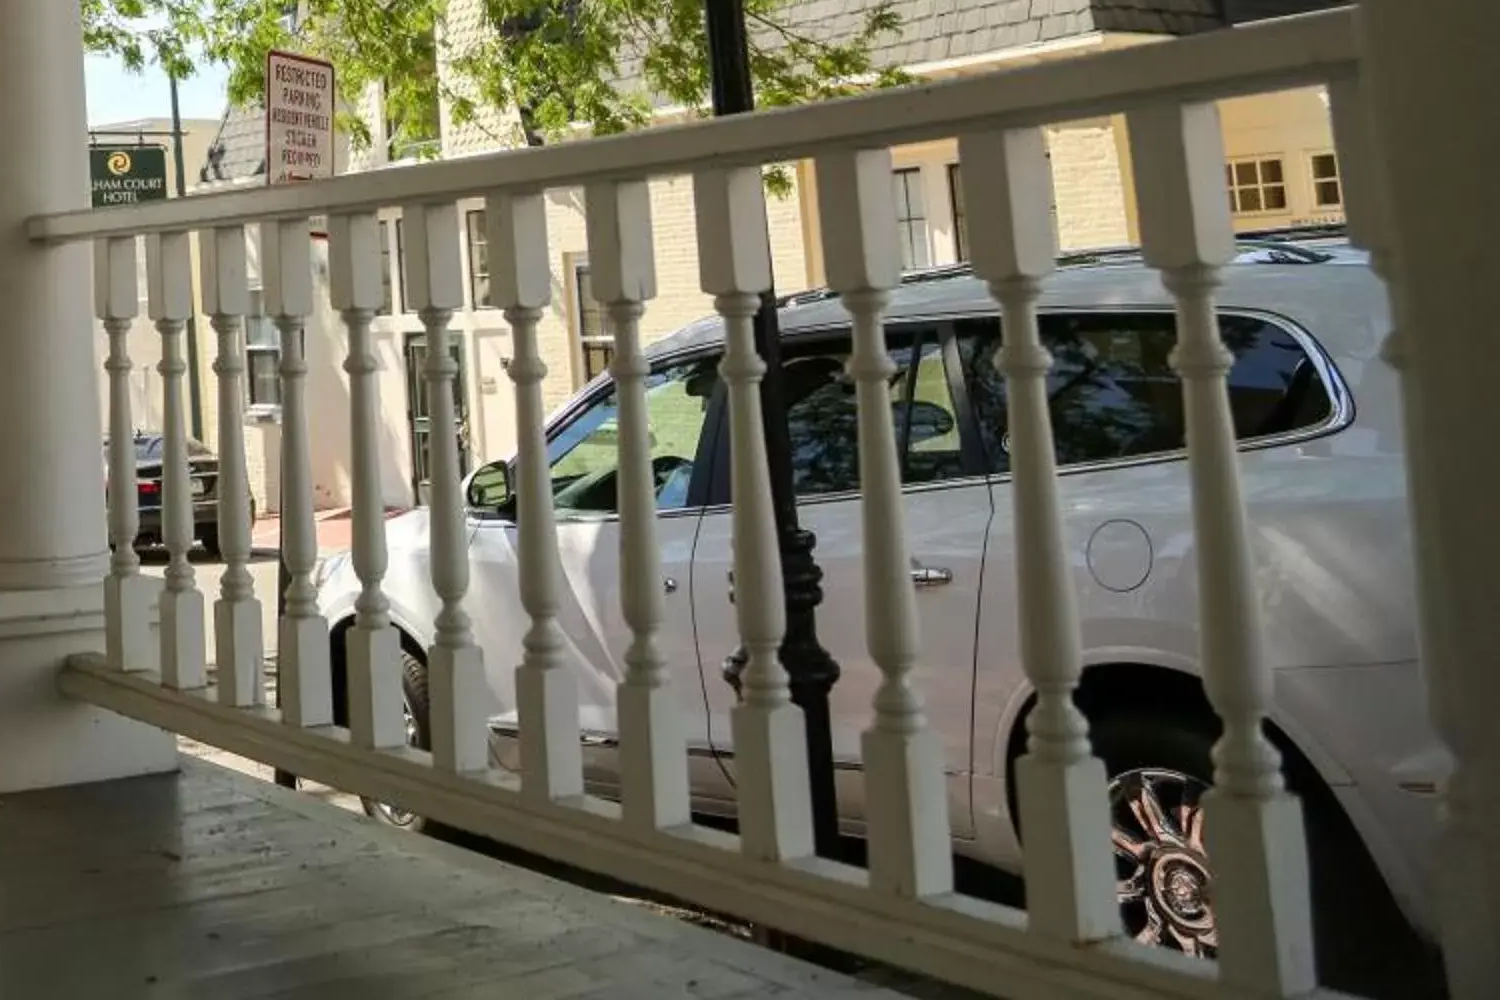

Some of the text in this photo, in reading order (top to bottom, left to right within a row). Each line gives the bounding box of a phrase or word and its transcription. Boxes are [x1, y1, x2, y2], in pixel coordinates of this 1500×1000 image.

[275, 63, 328, 89] RESTRICTED
[283, 87, 322, 112] PARKING
[93, 177, 163, 191] HAM COURT
[103, 191, 138, 203] HOTEL
